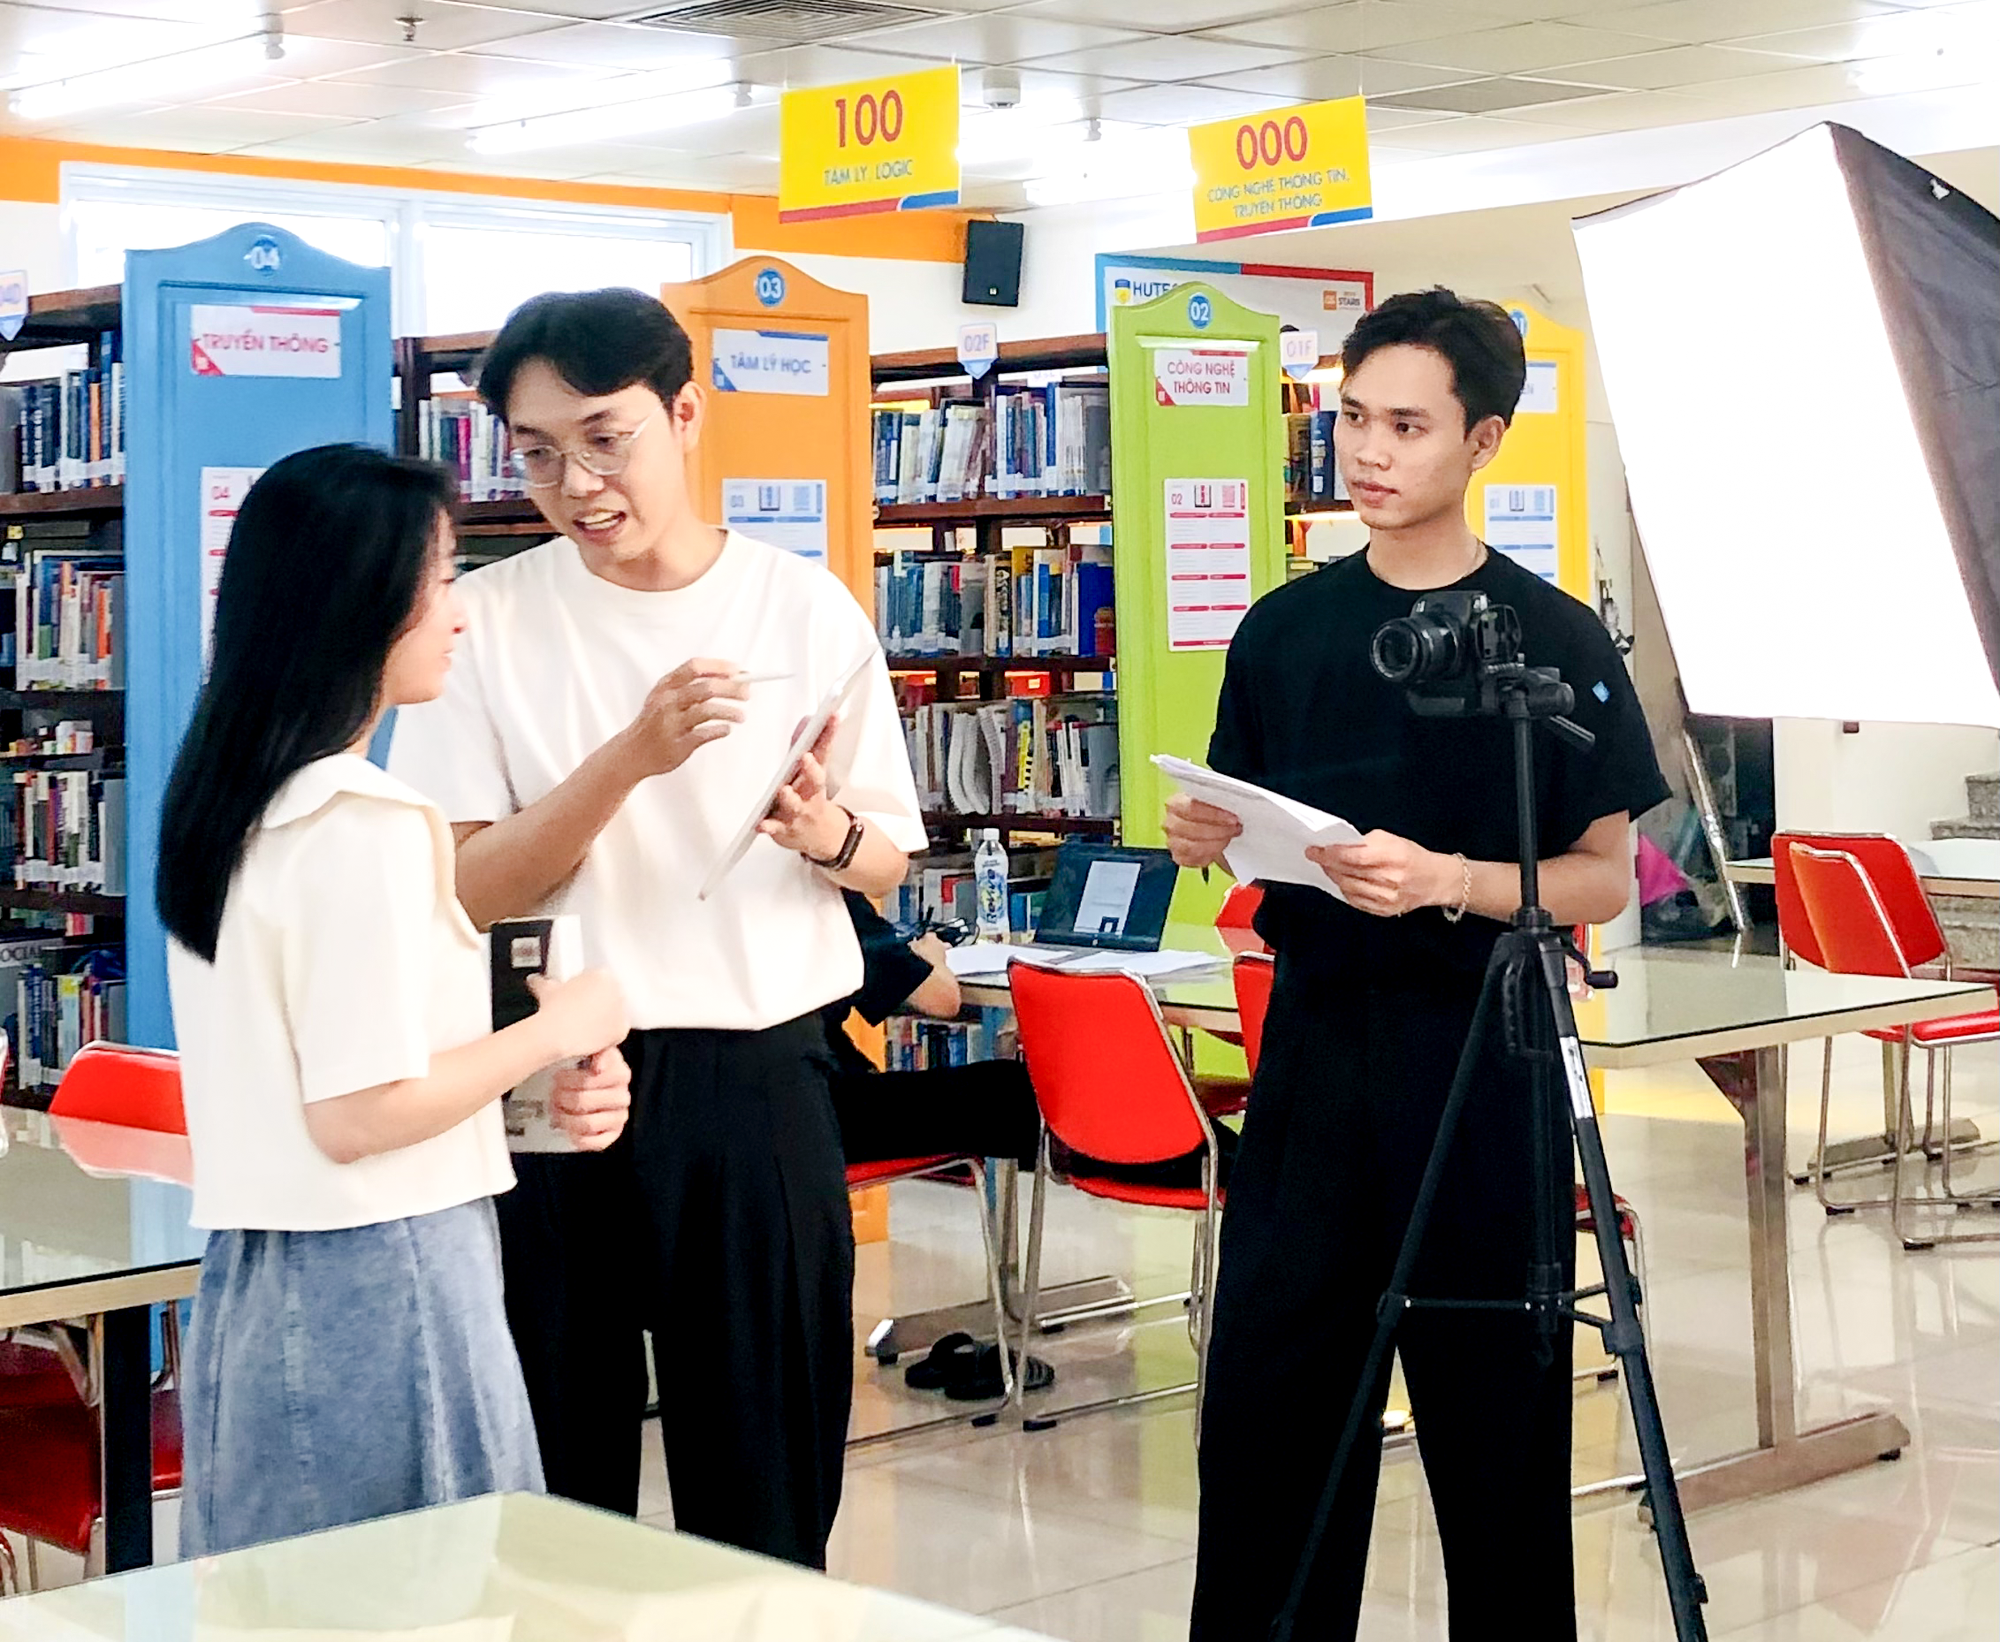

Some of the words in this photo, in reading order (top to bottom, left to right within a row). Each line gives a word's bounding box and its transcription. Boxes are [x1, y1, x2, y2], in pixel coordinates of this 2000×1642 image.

[835, 90, 903, 148] 100
[1236, 116, 1308, 170] 000
[875, 159, 914, 180] LOGIC
[250, 246, 280, 270] 04
[760, 276, 782, 299] 03
[1133, 281, 1178, 297] HUTE
[1190, 301, 1209, 321] 02
[964, 333, 990, 352] 02F
[781, 359, 811, 376] HỌC
[1214, 381, 1231, 394] TIN
[212, 485, 230, 500] 04
[1171, 493, 1183, 506] 02
